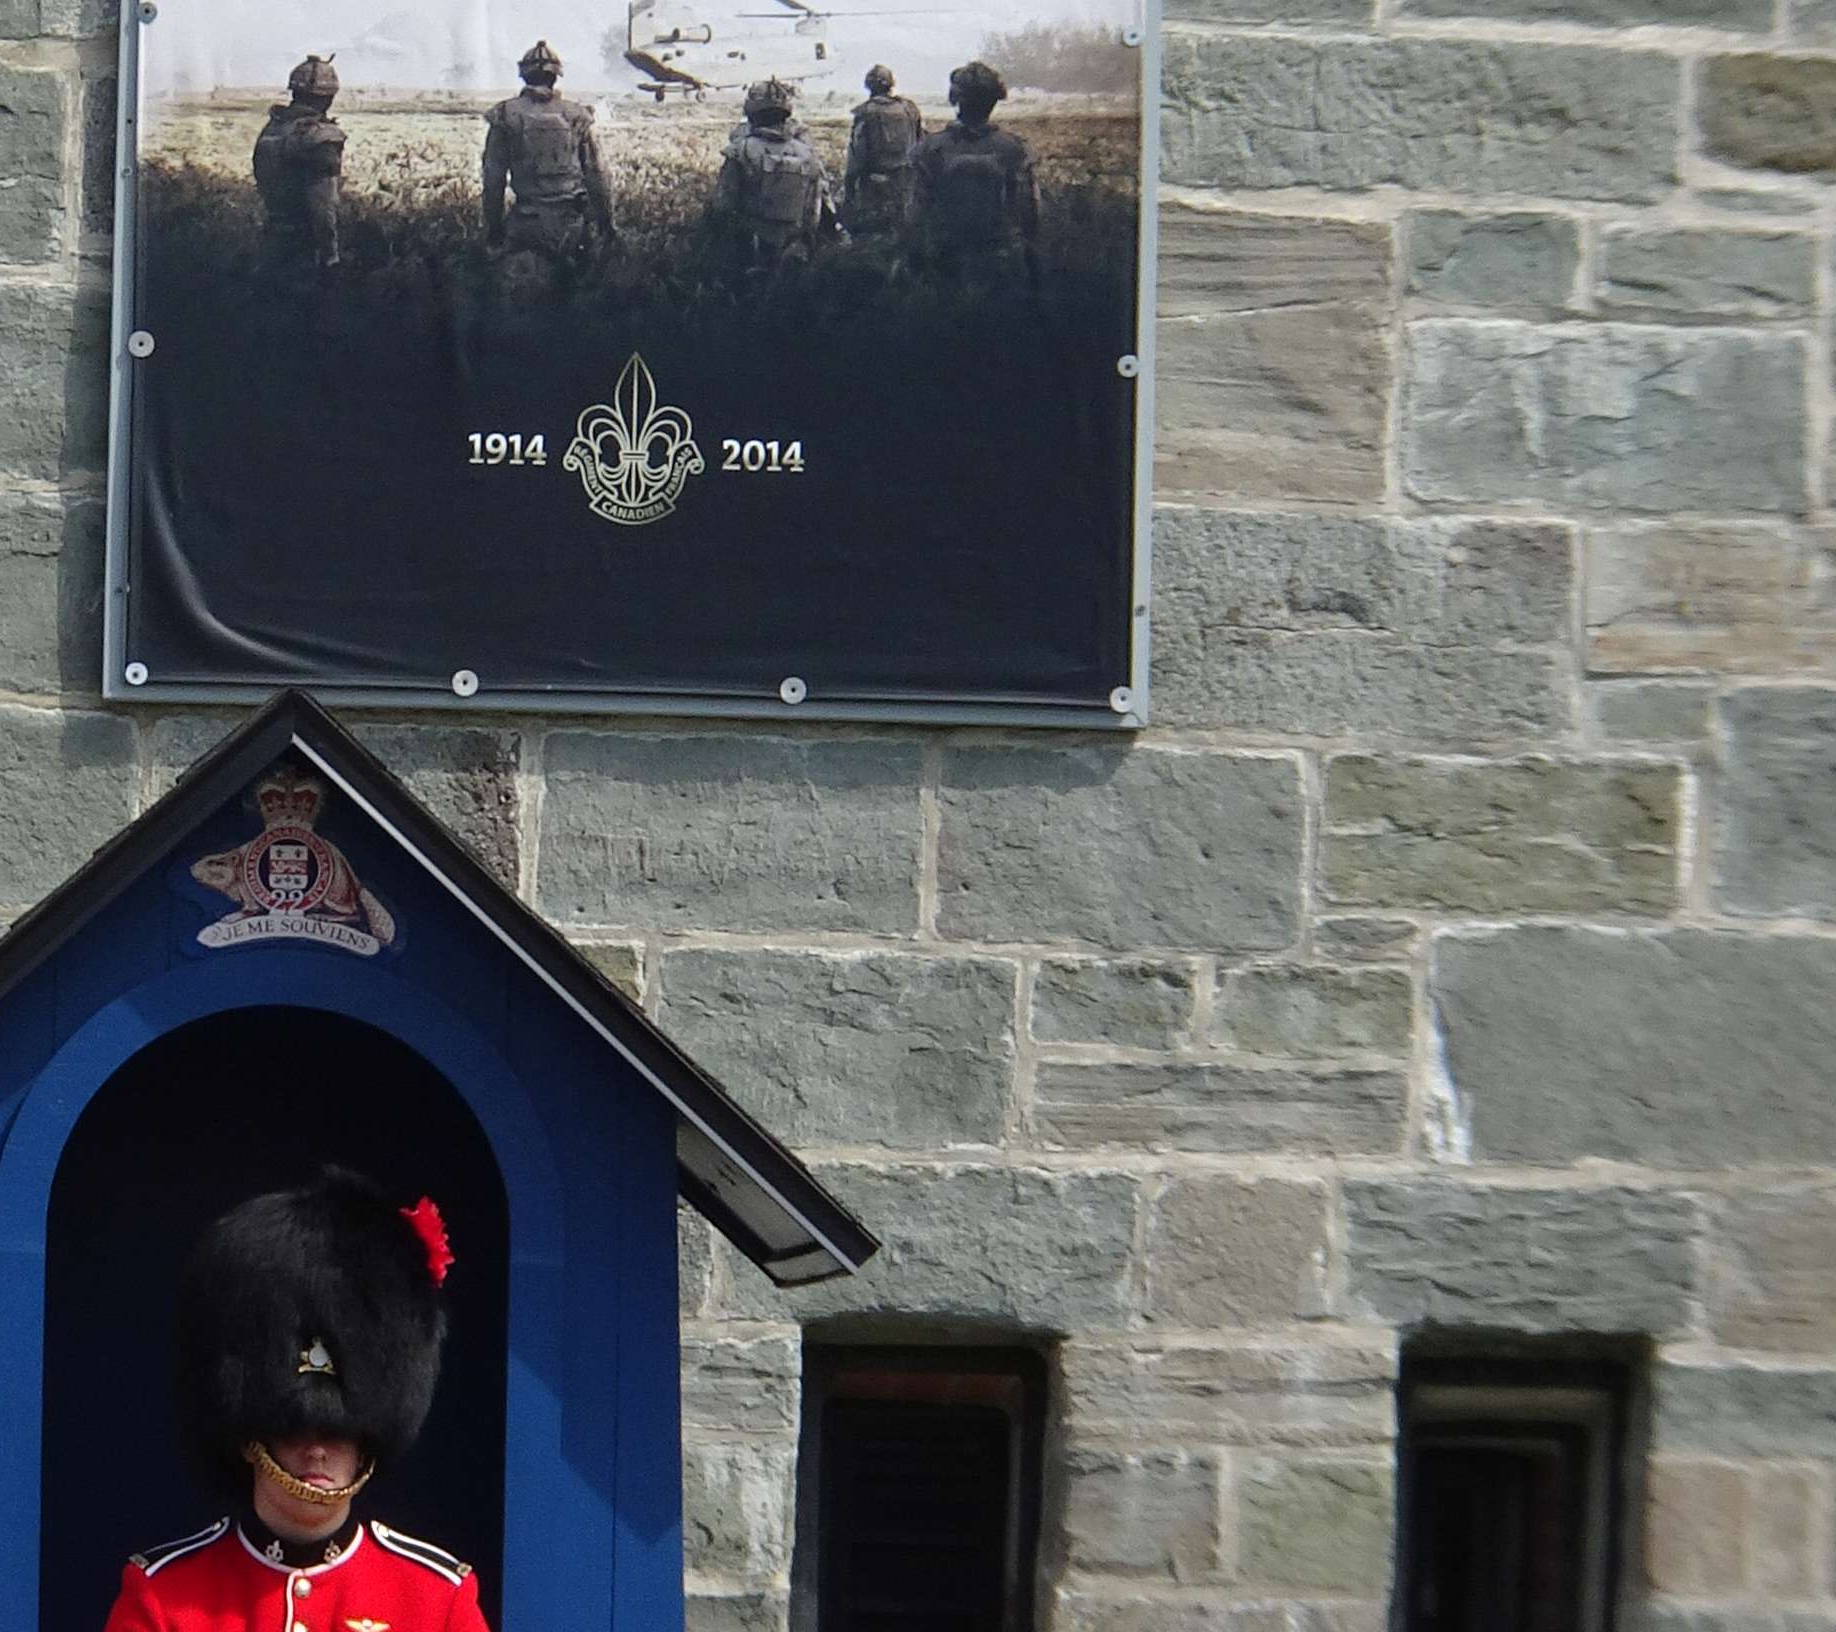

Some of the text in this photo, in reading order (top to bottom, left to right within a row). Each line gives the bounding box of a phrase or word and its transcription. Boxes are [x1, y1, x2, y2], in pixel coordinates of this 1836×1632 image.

[467, 433, 548, 466] 1914
[721, 439, 805, 473] 2014
[601, 500, 664, 520] CANADIEN
[269, 889, 306, 915] 22
[223, 917, 371, 949] JE ME SOUVIENS
